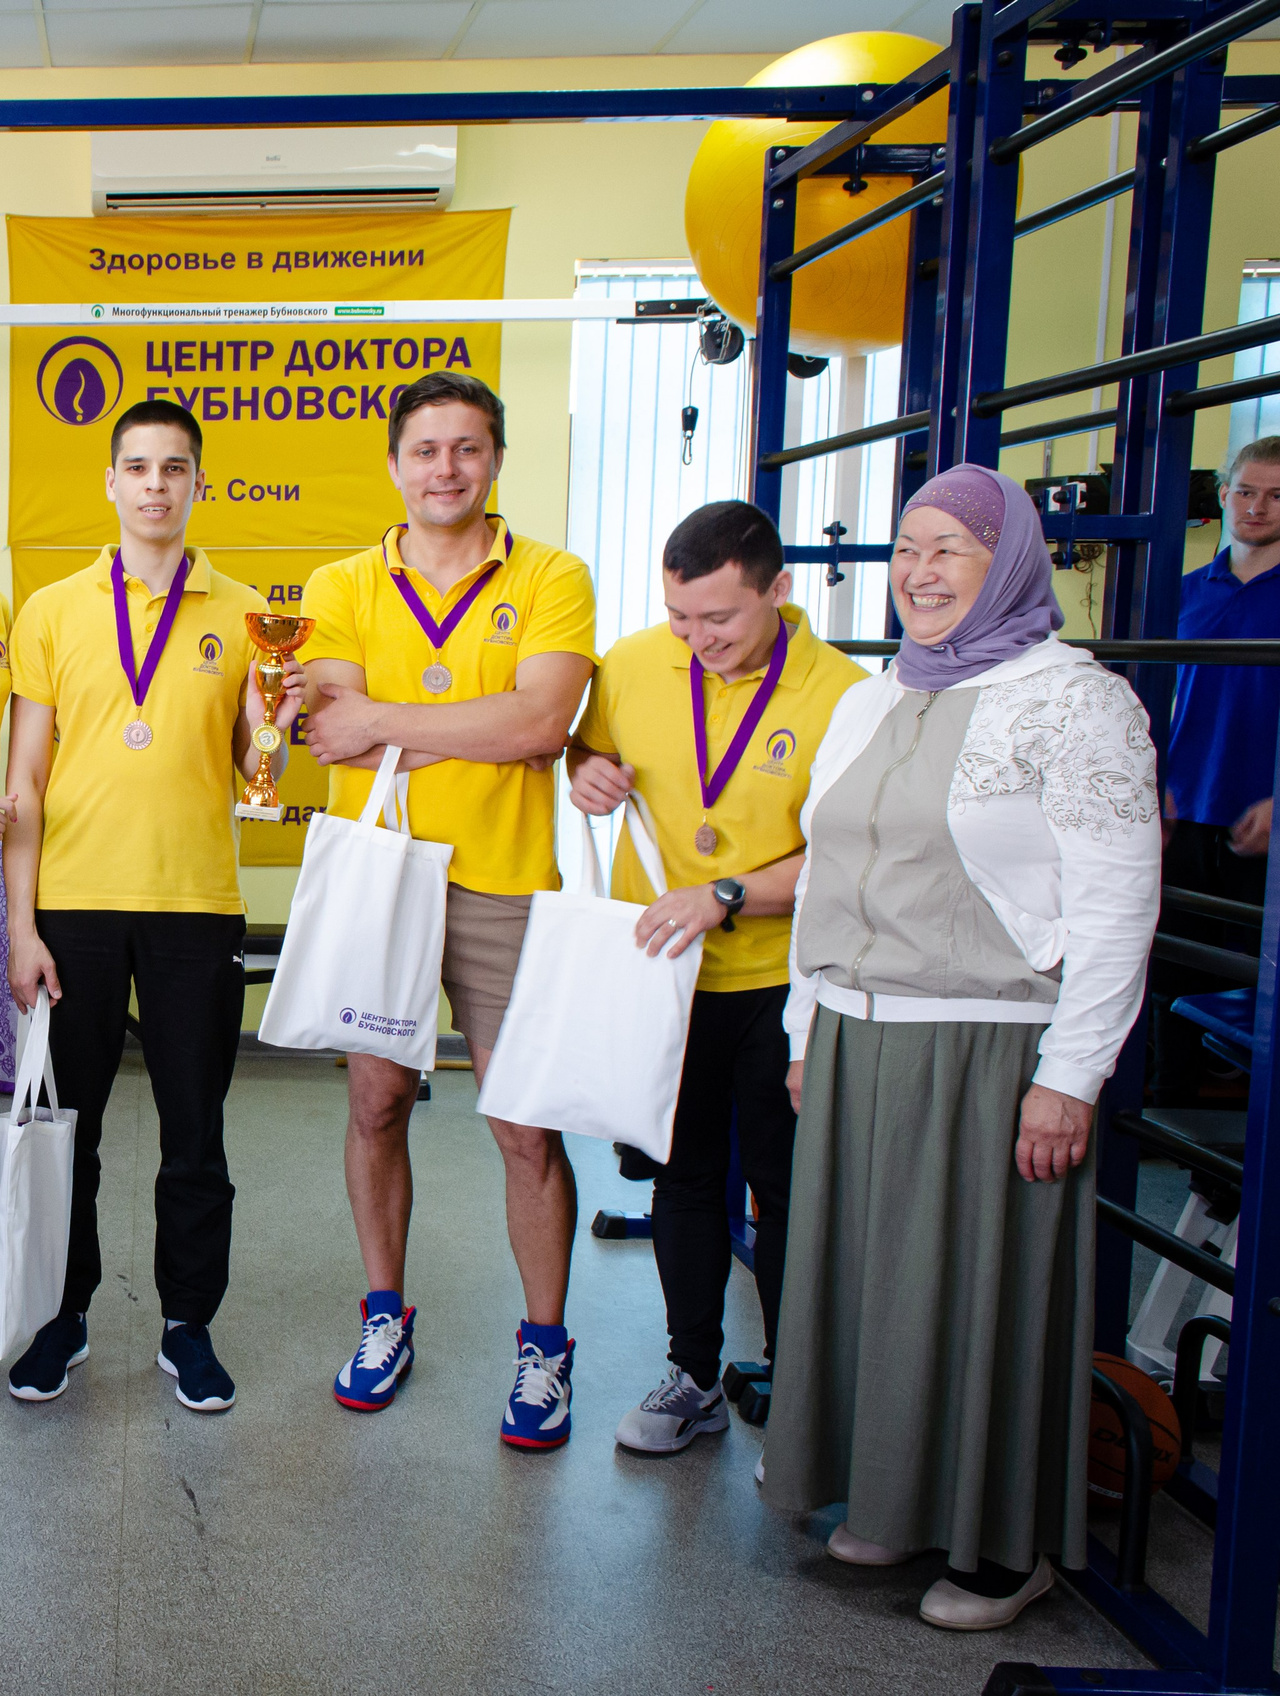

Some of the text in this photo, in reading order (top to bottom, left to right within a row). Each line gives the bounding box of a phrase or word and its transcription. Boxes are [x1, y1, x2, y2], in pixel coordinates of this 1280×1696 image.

[89, 248, 425, 275] Здоровье в движении
[112, 306, 328, 318] Многофункциональный тренажер Бубновского
[146, 336, 472, 377] ЦЕНТР ДОКТОРА
[227, 478, 300, 501] Сочи
[361, 1011, 387, 1024] ЦЕНТР
[358, 1020, 416, 1036] БУБНОВСКОГО
